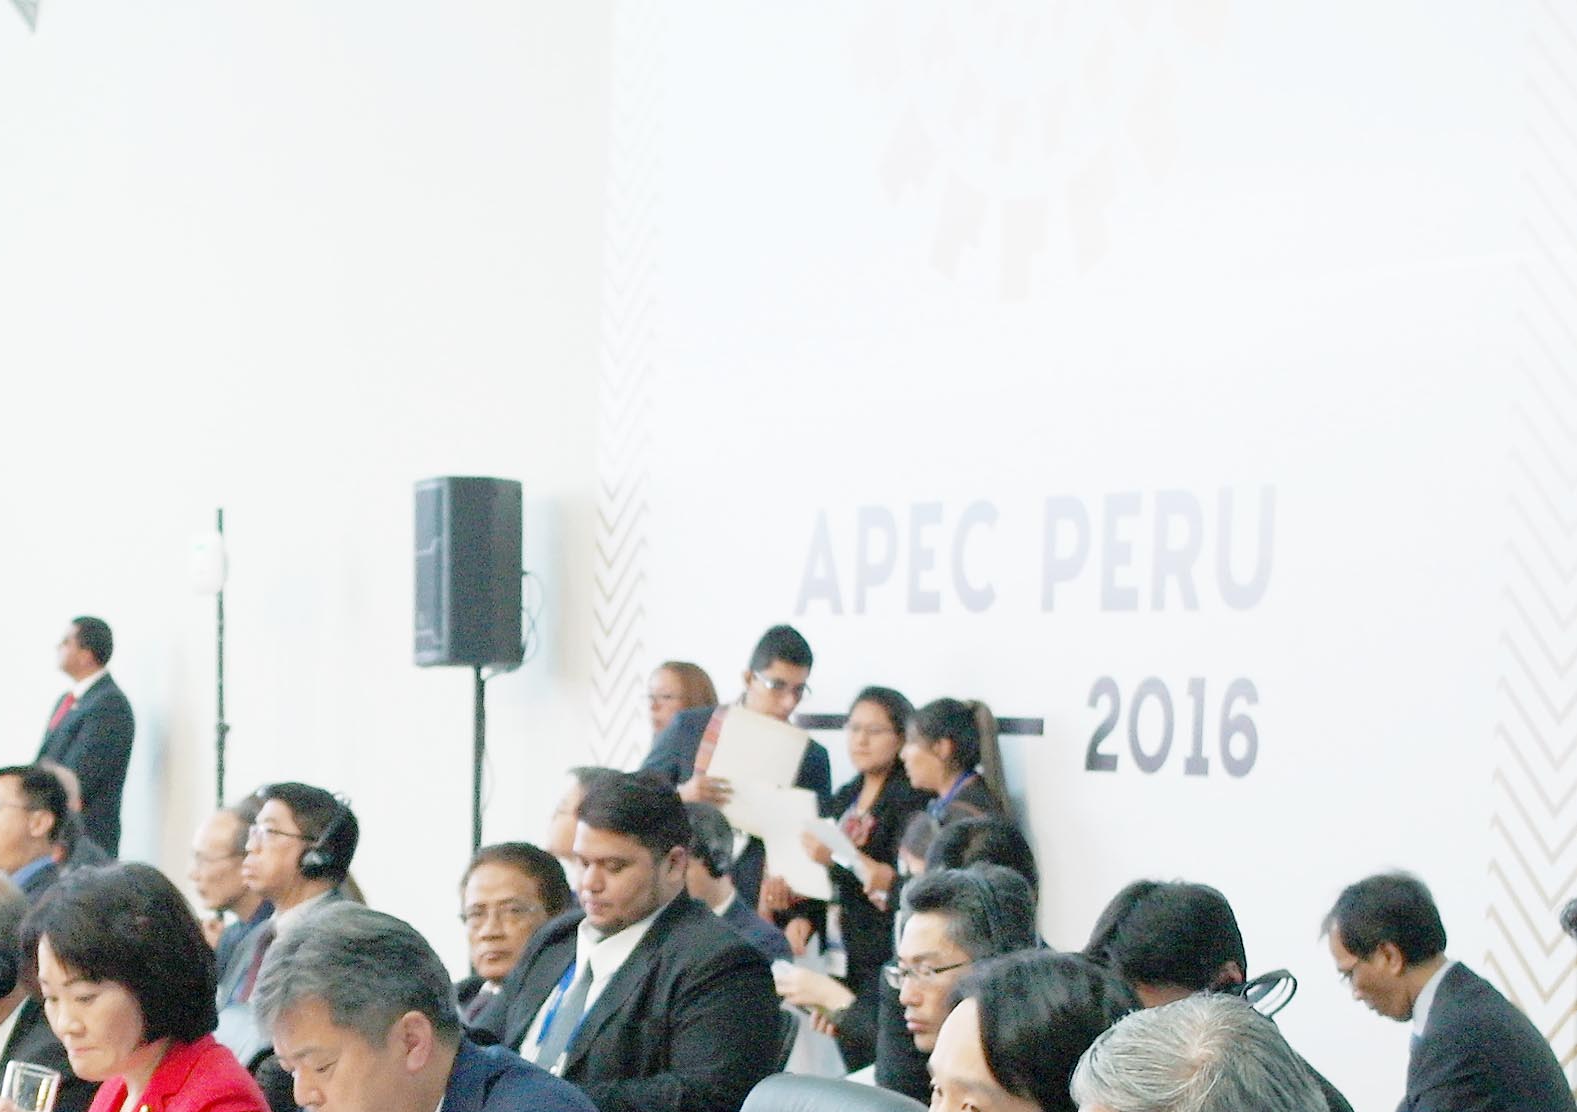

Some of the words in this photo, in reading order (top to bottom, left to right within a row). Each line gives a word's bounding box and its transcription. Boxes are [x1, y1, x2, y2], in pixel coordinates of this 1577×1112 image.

[794, 498, 1000, 616] APEC
[1040, 483, 1277, 614] PERU
[1084, 675, 1259, 778] 2016
